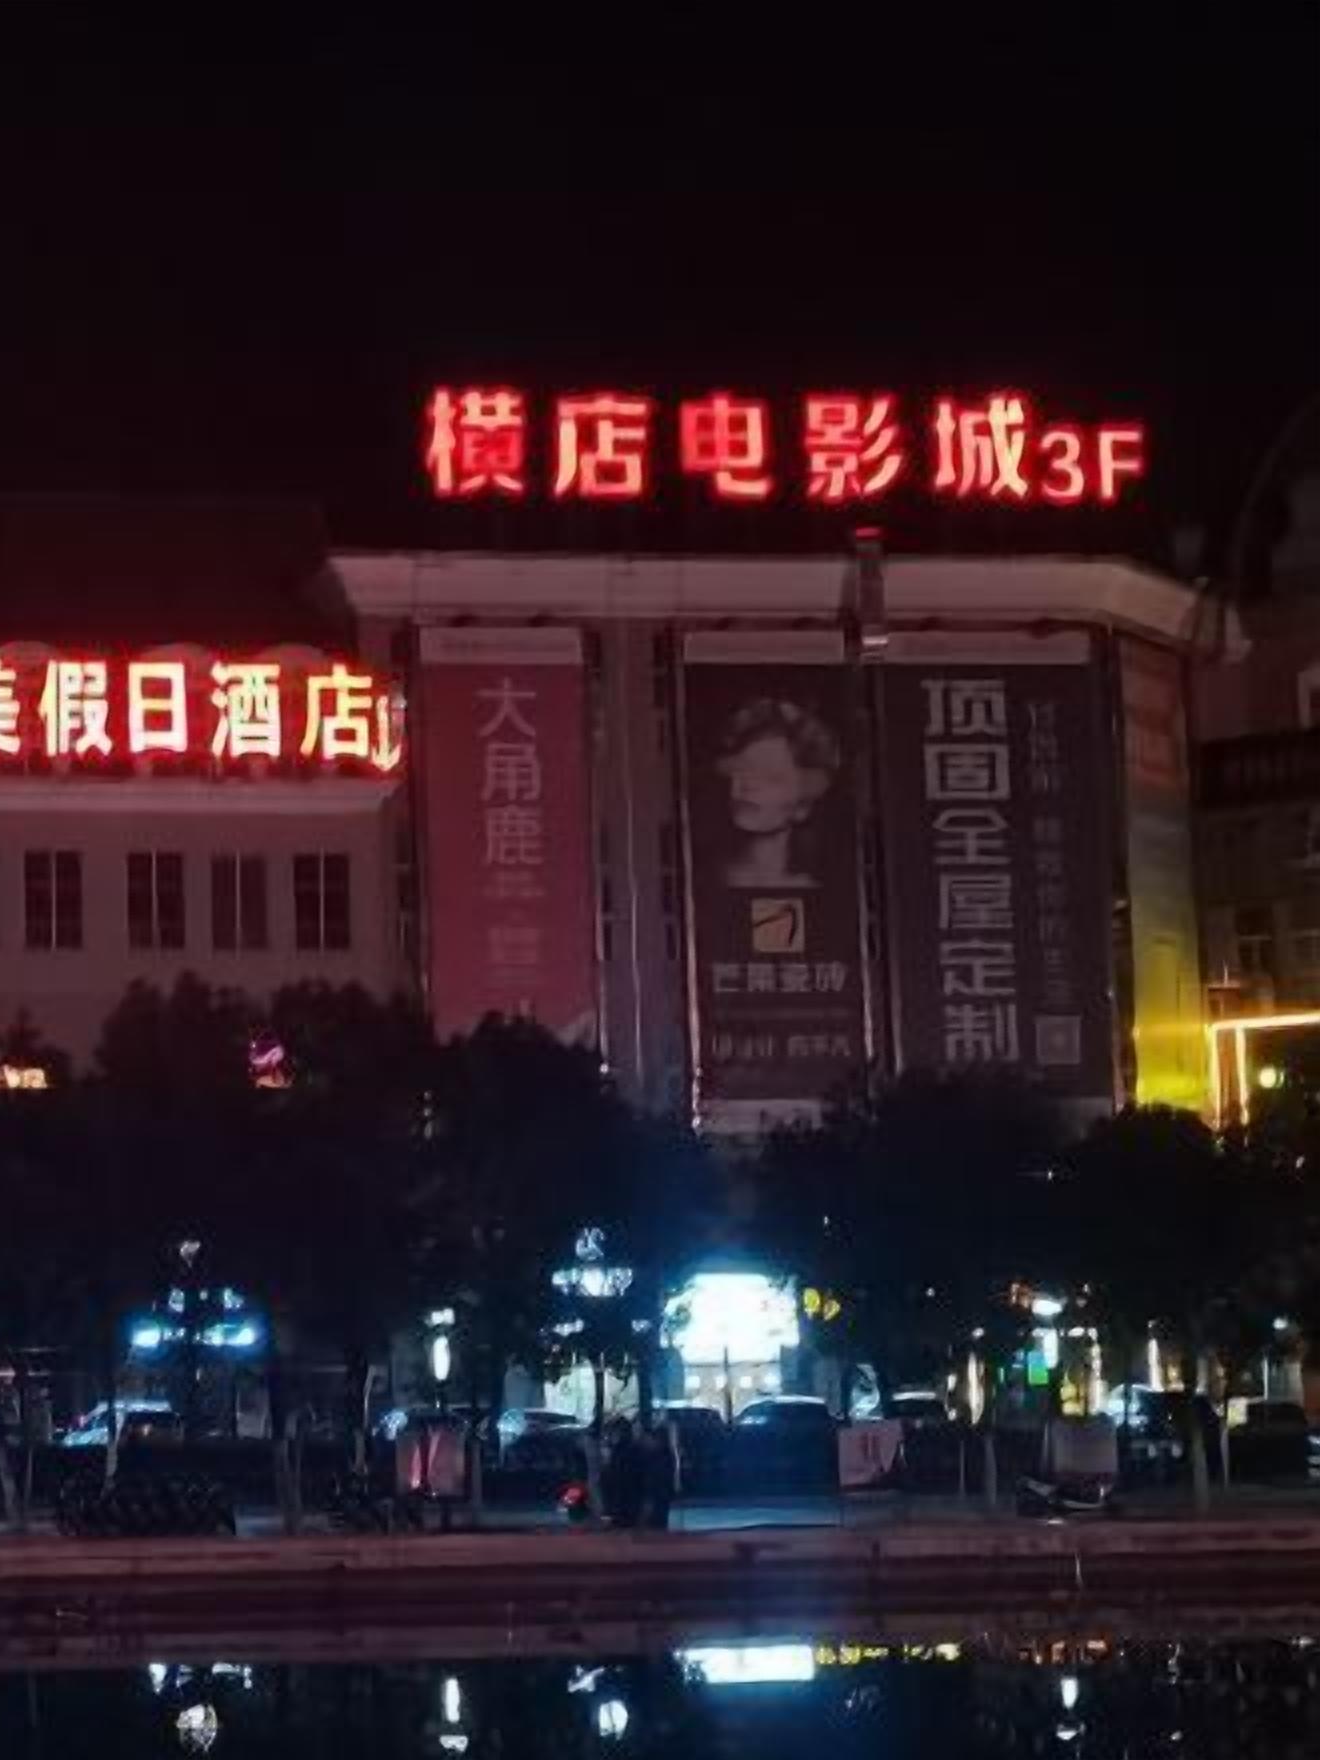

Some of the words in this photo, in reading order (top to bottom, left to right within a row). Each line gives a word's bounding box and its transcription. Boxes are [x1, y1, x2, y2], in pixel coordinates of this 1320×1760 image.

[920, 678, 1020, 1061] 顶固全屋定制
